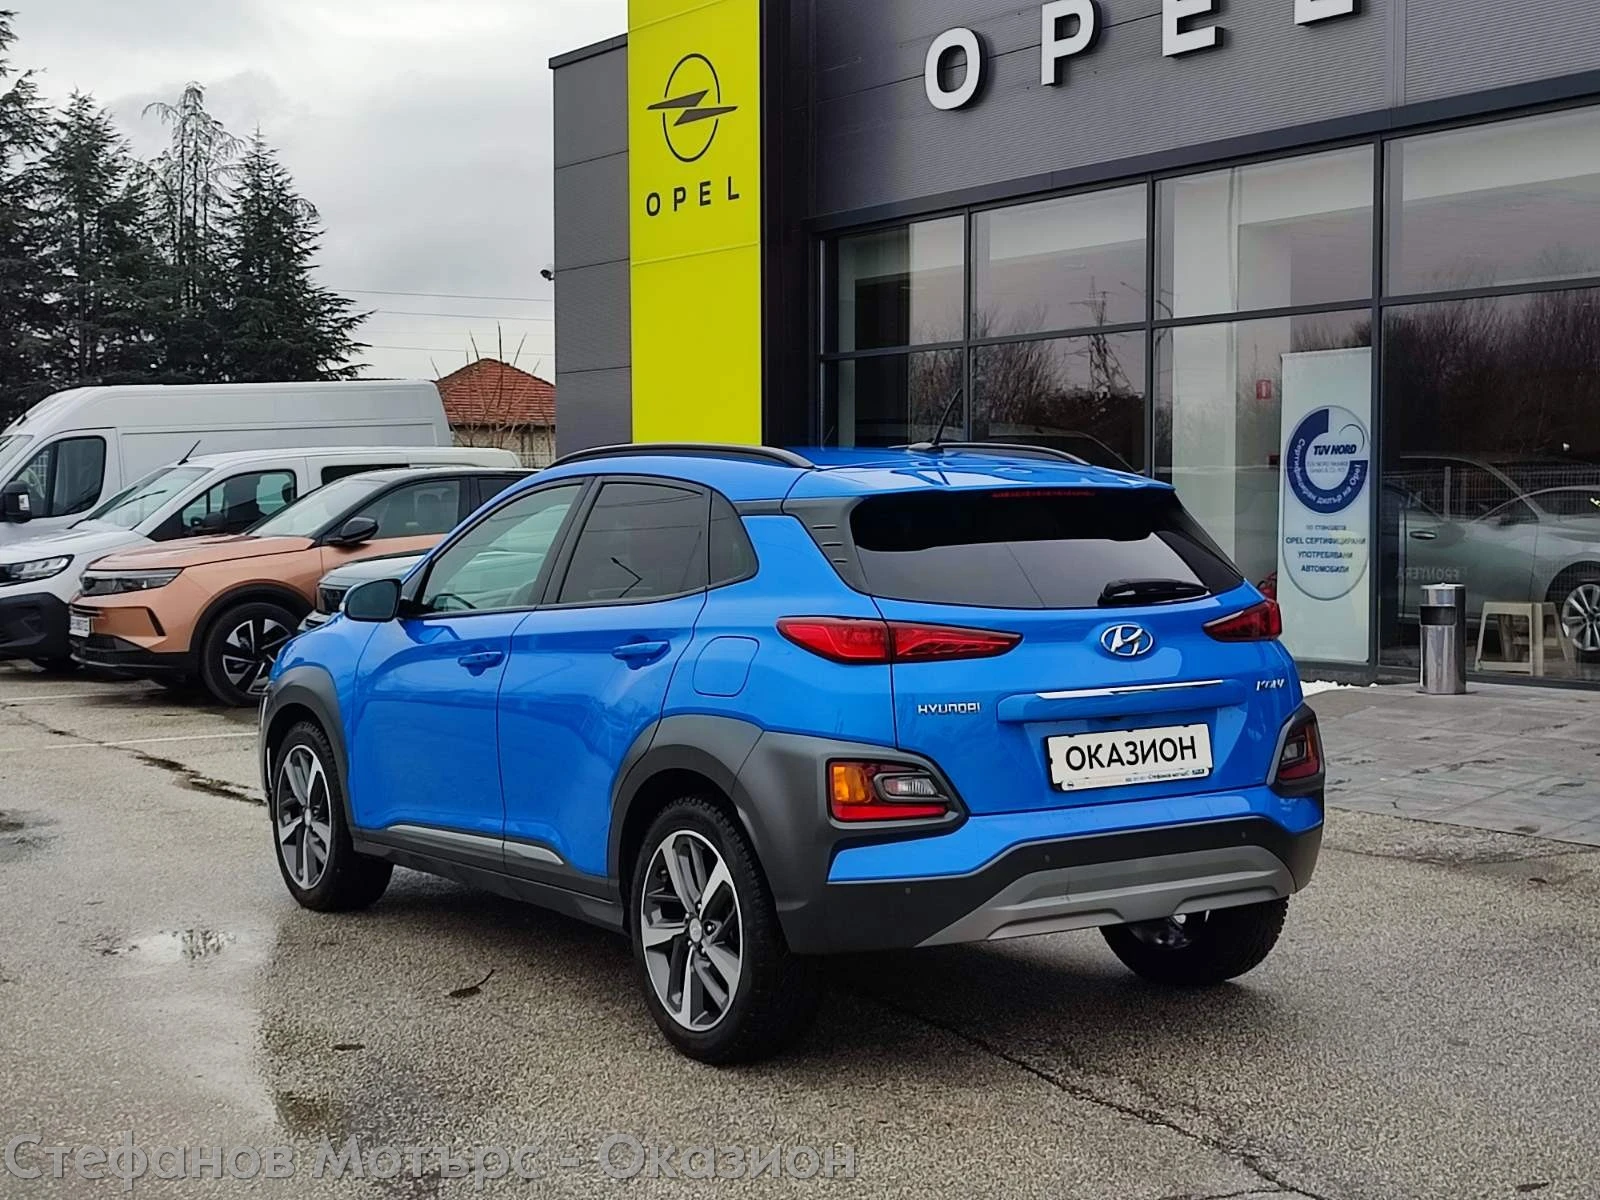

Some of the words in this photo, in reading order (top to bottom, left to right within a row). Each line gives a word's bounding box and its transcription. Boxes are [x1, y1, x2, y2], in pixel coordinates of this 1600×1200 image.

[646, 176, 740, 217] OPEL
[1331, 444, 1357, 455] NORD
[1285, 536, 1304, 544] OPEL
[917, 702, 981, 714] HYUNDAI
[1065, 735, 1197, 771] ОКАЗИОН
